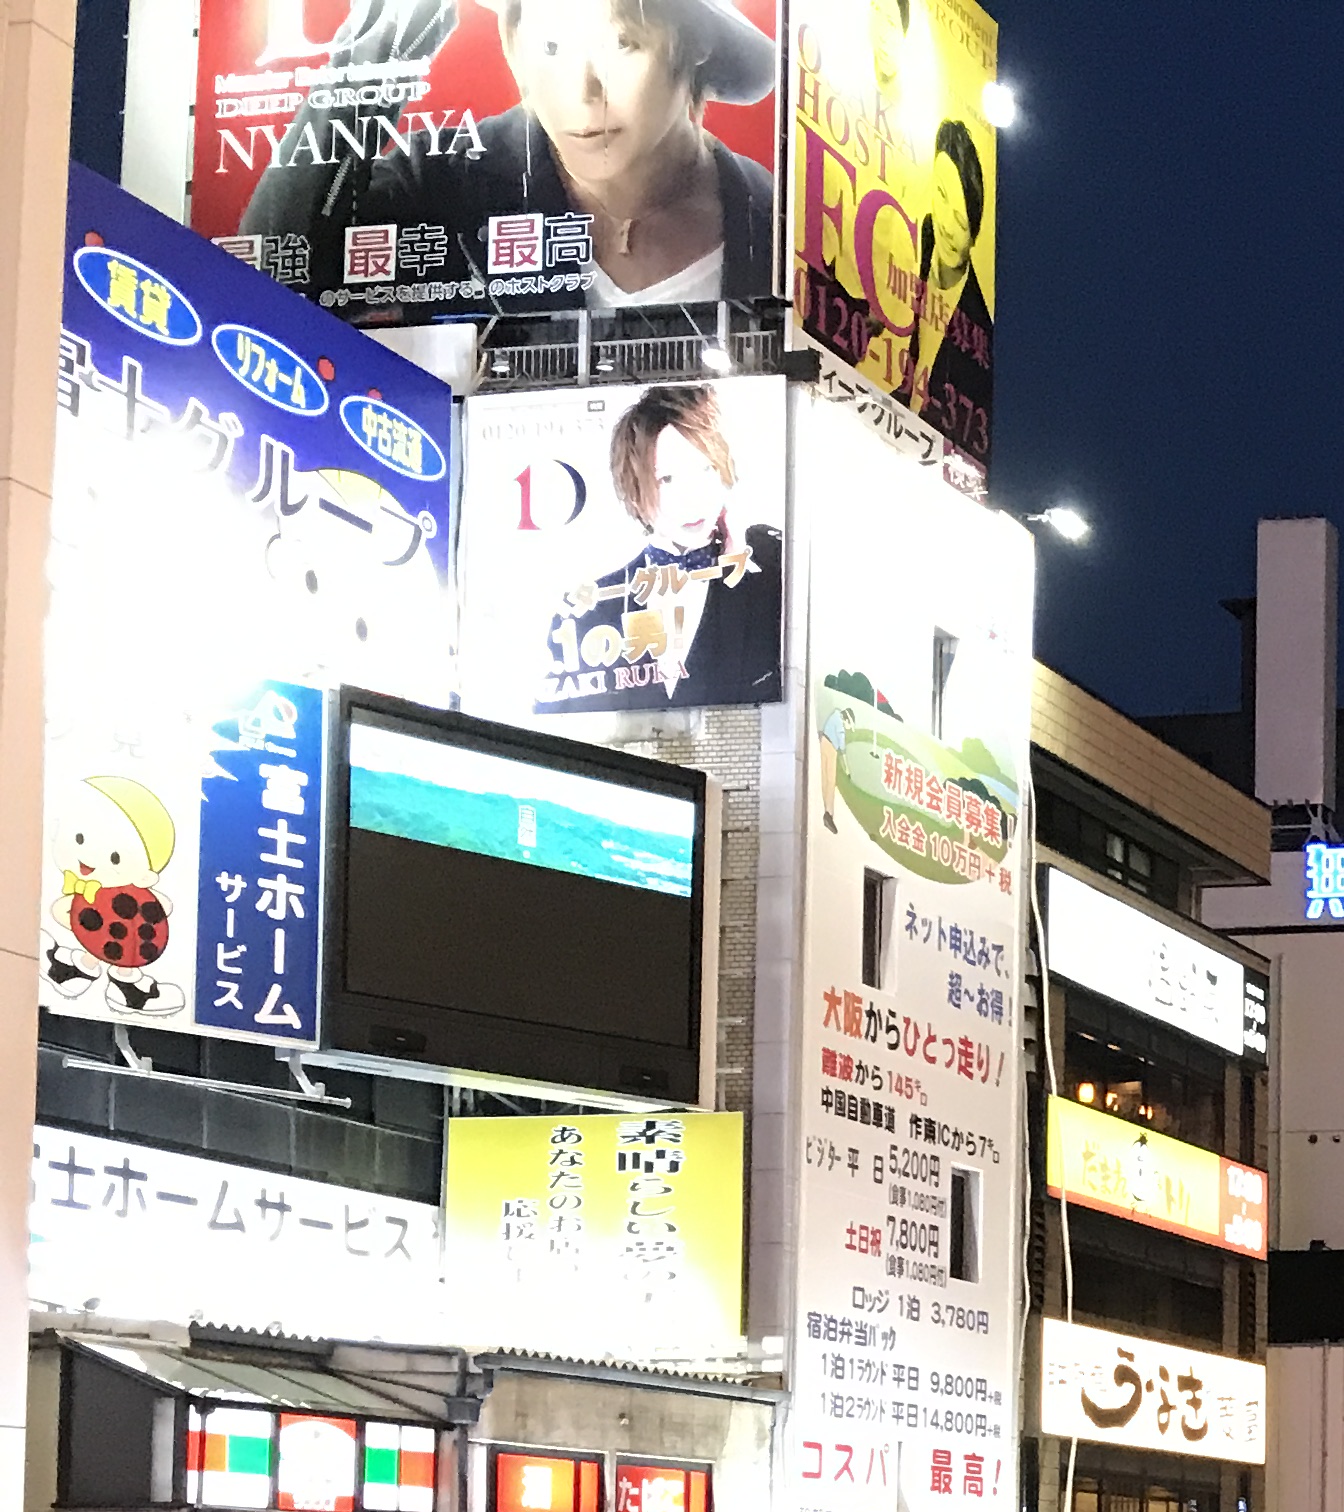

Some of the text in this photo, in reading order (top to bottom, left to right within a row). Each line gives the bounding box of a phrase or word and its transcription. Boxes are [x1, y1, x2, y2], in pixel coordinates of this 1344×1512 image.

[215, 81, 431, 118] DEEP GROUP
[796, 64, 889, 186] HOST
[215, 108, 487, 173] NYANNYA
[347, 223, 448, 282] 最幸
[492, 212, 594, 270] 最高
[795, 115, 919, 337] FC
[106, 259, 172, 336] 賃貸
[235, 331, 309, 410] リフォーム
[793, 266, 988, 454] 0120-194-373
[361, 402, 424, 475] 中古流通
[809, 345, 937, 461] ィープグループ
[562, 546, 755, 611] ターグループ
[614, 659, 690, 691] RUKA
[255, 761, 310, 1030] 富士ホーム
[213, 870, 248, 1012] サービス
[820, 1085, 896, 1135] 中国自動車道
[33, 1143, 413, 1261] 士ホームサービス
[618, 1120, 686, 1303] 素晴らしい夢の
[930, 1301, 989, 1336] 3,780円
[1080, 1346, 1211, 1442] うなぎ
[801, 1440, 1002, 1498] コスパ 最高!
